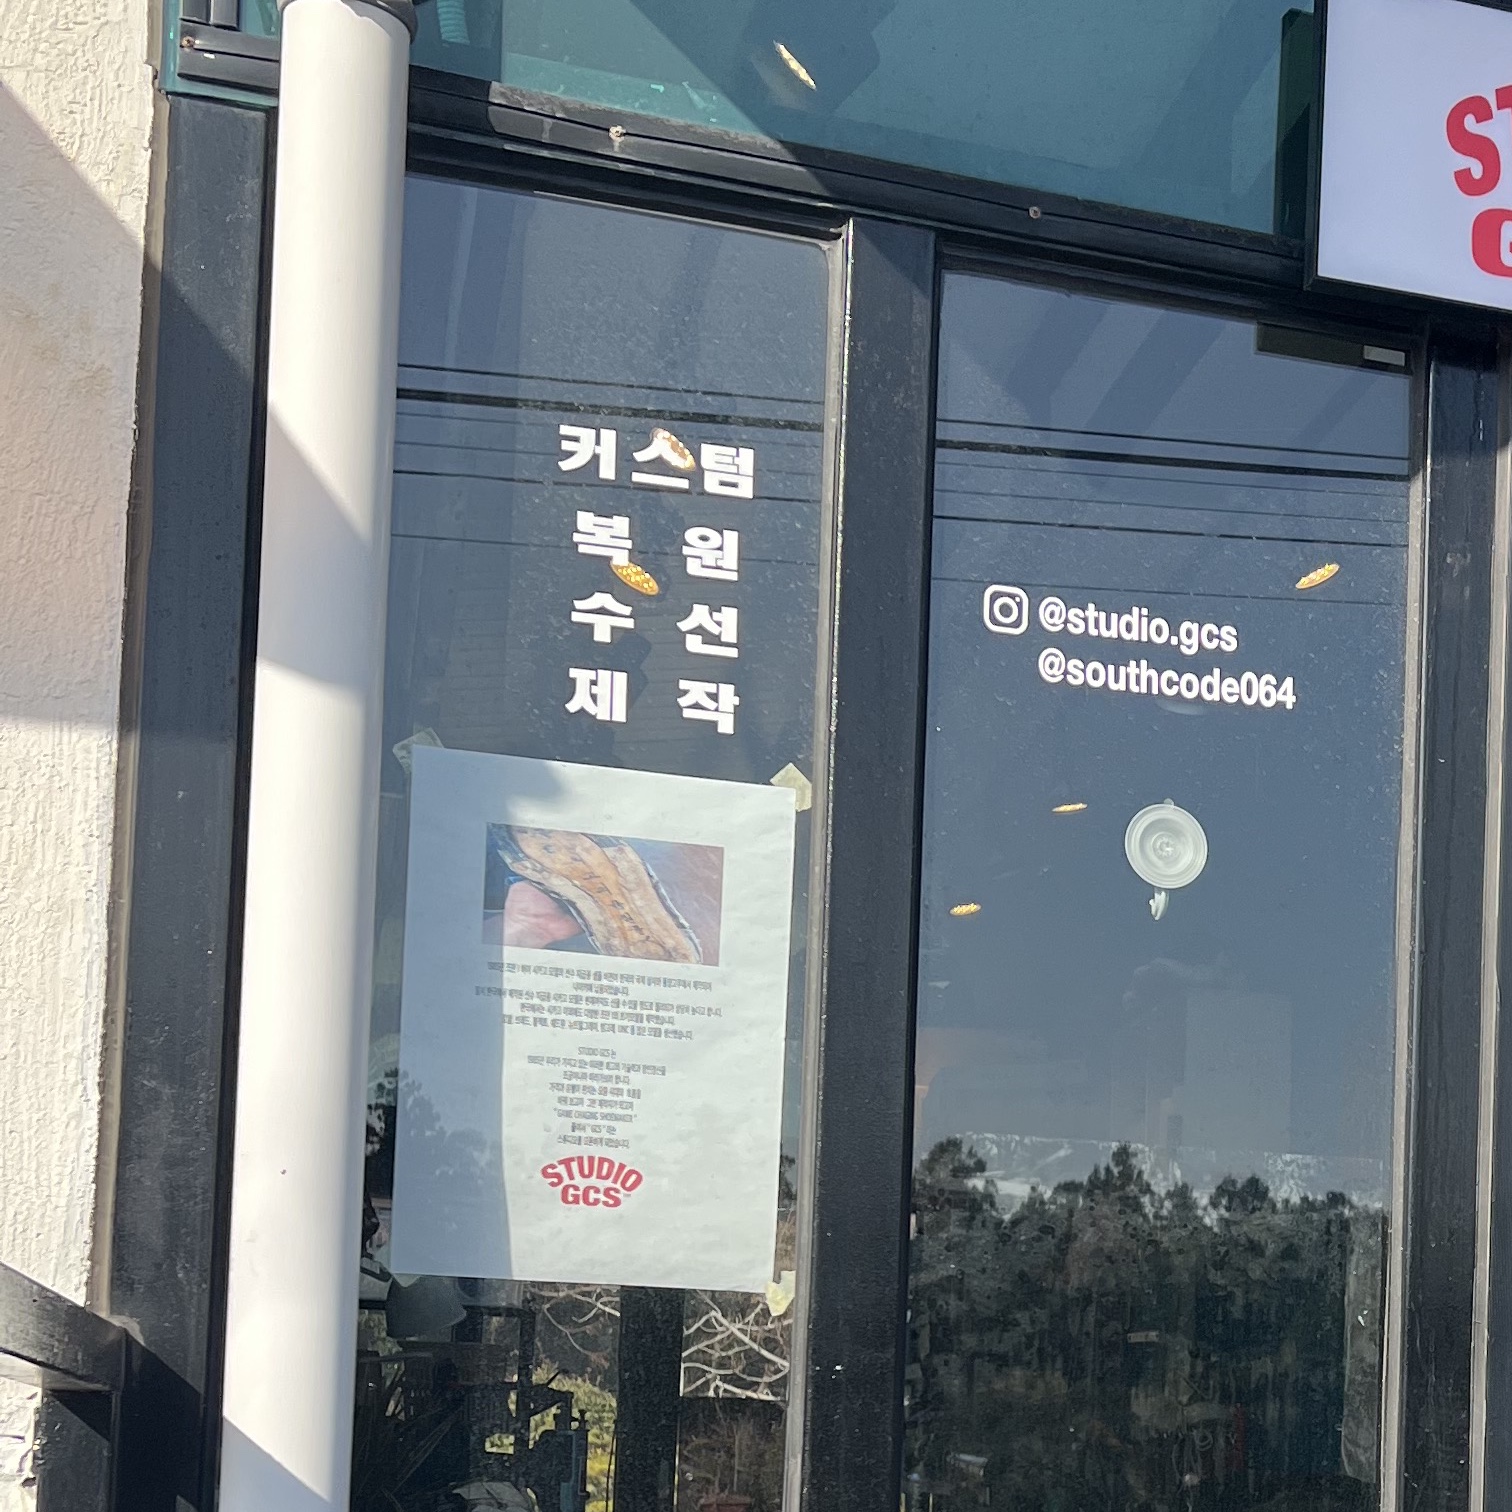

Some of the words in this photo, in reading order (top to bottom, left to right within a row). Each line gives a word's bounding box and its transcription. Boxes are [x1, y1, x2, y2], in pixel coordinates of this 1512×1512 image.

[558, 424, 754, 498] 커스텀
[1039, 596, 1238, 655] @studio.gcs
[1038, 647, 1296, 709] @southcode064
[540, 1155, 643, 1192] STUDIO
[561, 1184, 622, 1208] GCS
